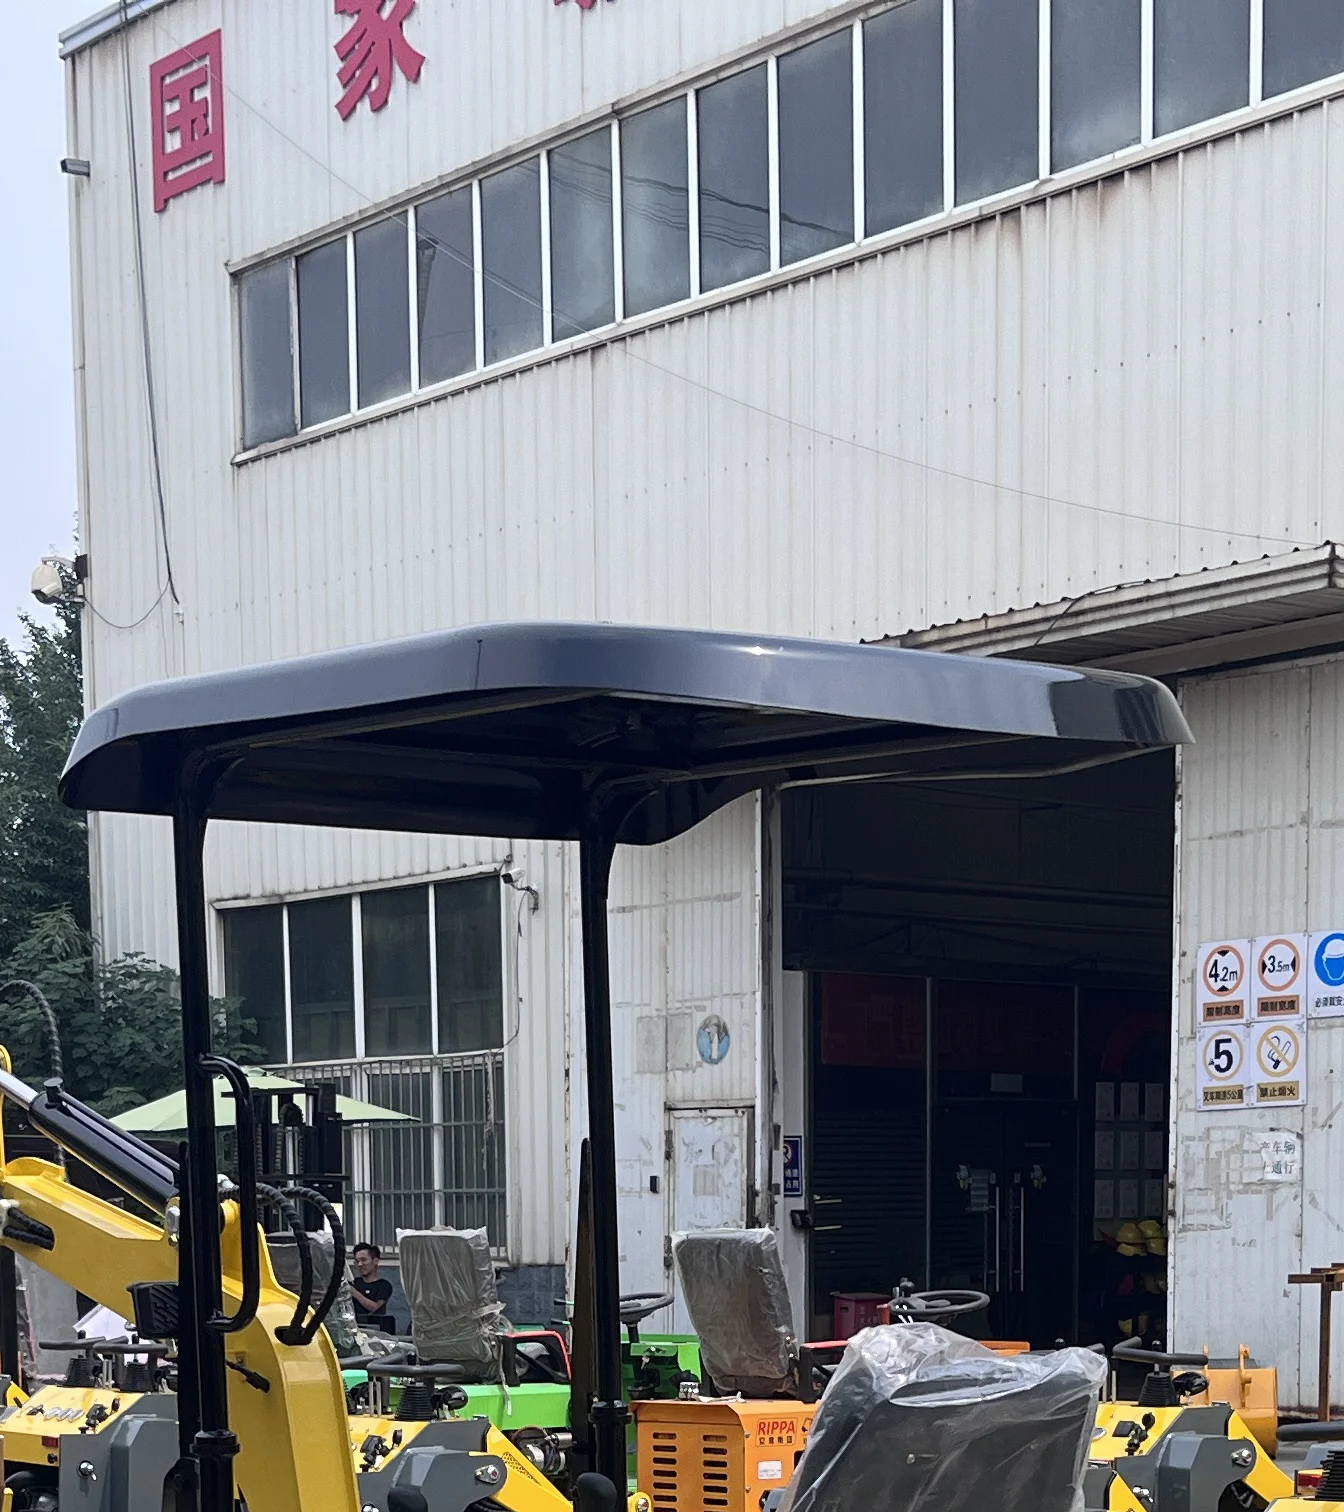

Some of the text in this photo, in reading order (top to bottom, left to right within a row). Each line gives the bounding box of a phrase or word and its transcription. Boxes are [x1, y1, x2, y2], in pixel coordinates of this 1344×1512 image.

[1208, 959, 1238, 983] 4.2m
[1267, 955, 1290, 974] 3.5m
[1213, 1038, 1234, 1073] 5
[758, 1421, 795, 1435] RIPPA
